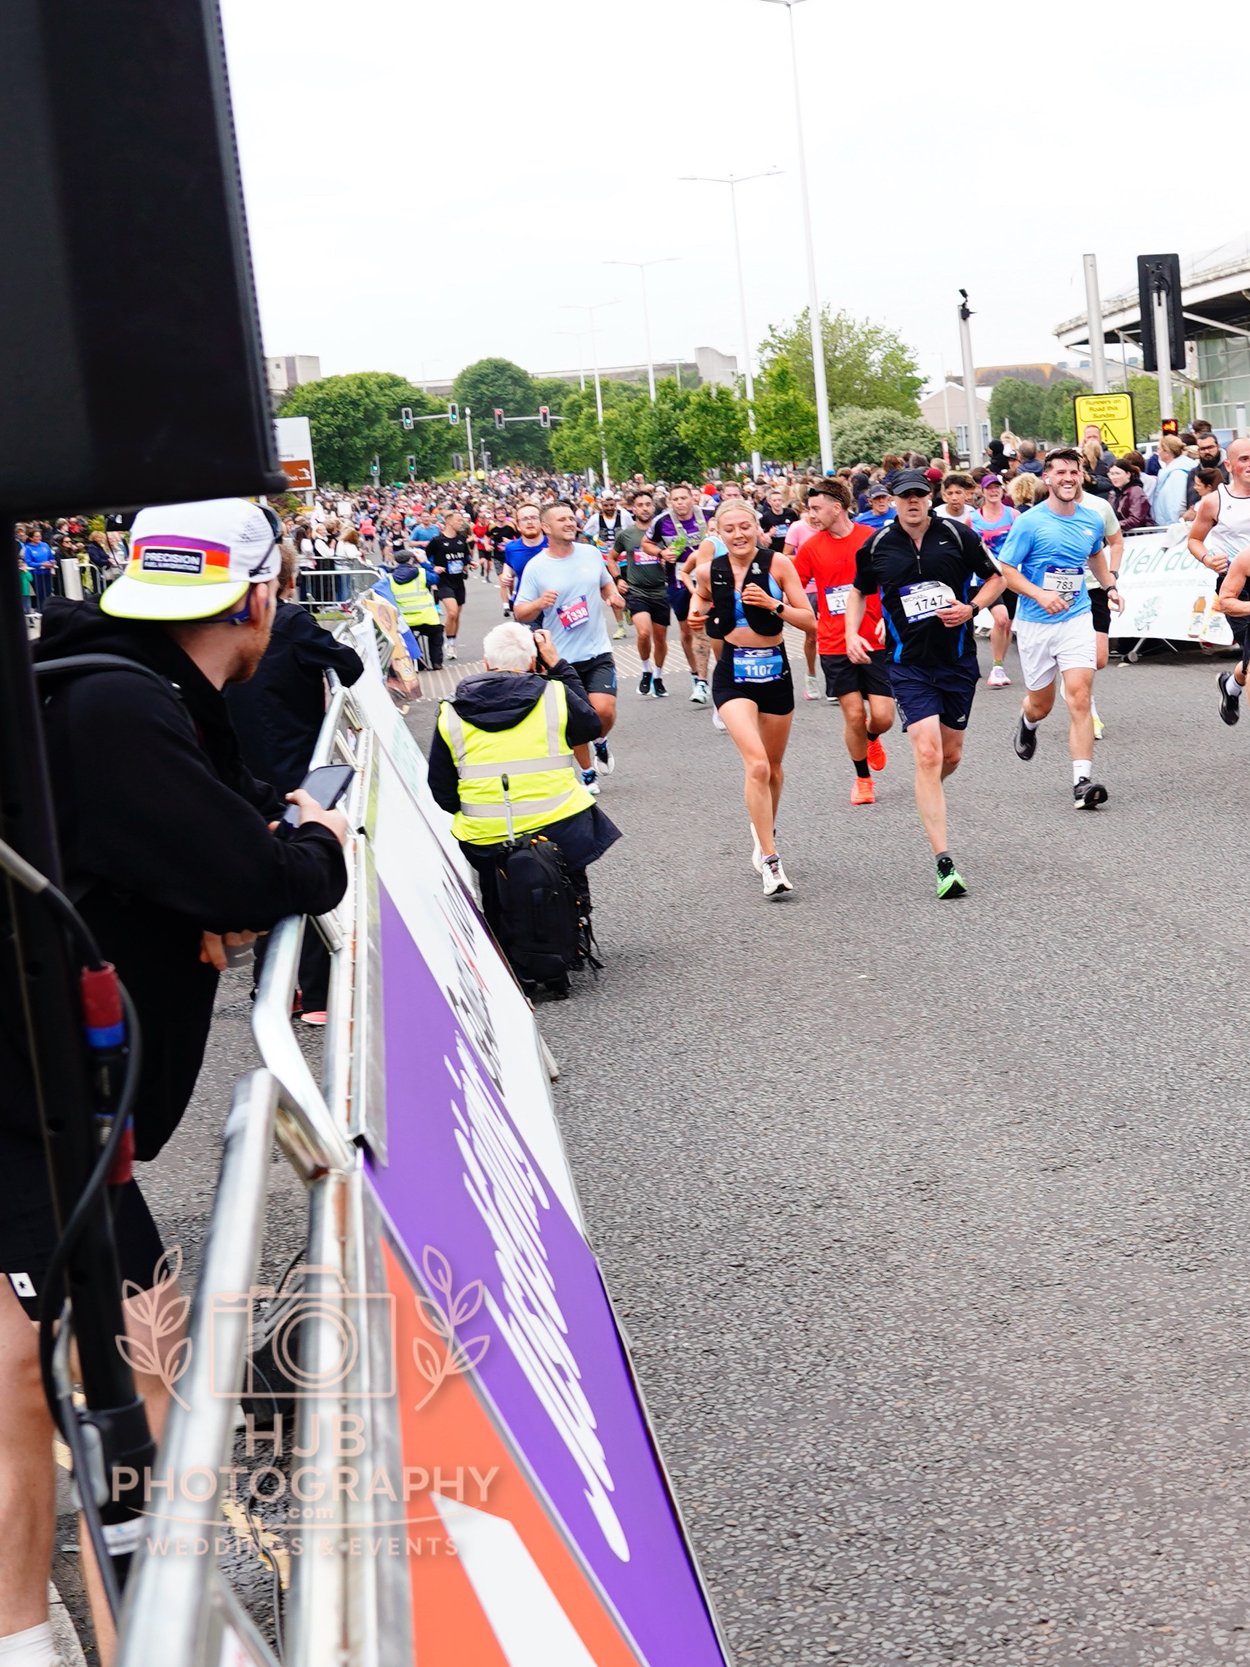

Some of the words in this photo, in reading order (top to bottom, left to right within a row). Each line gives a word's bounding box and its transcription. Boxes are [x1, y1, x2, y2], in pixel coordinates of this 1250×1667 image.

[145, 552, 200, 566] PRECISION
[1056, 581, 1074, 590] 783
[914, 594, 944, 612] 1747
[745, 664, 774, 676] 1107
